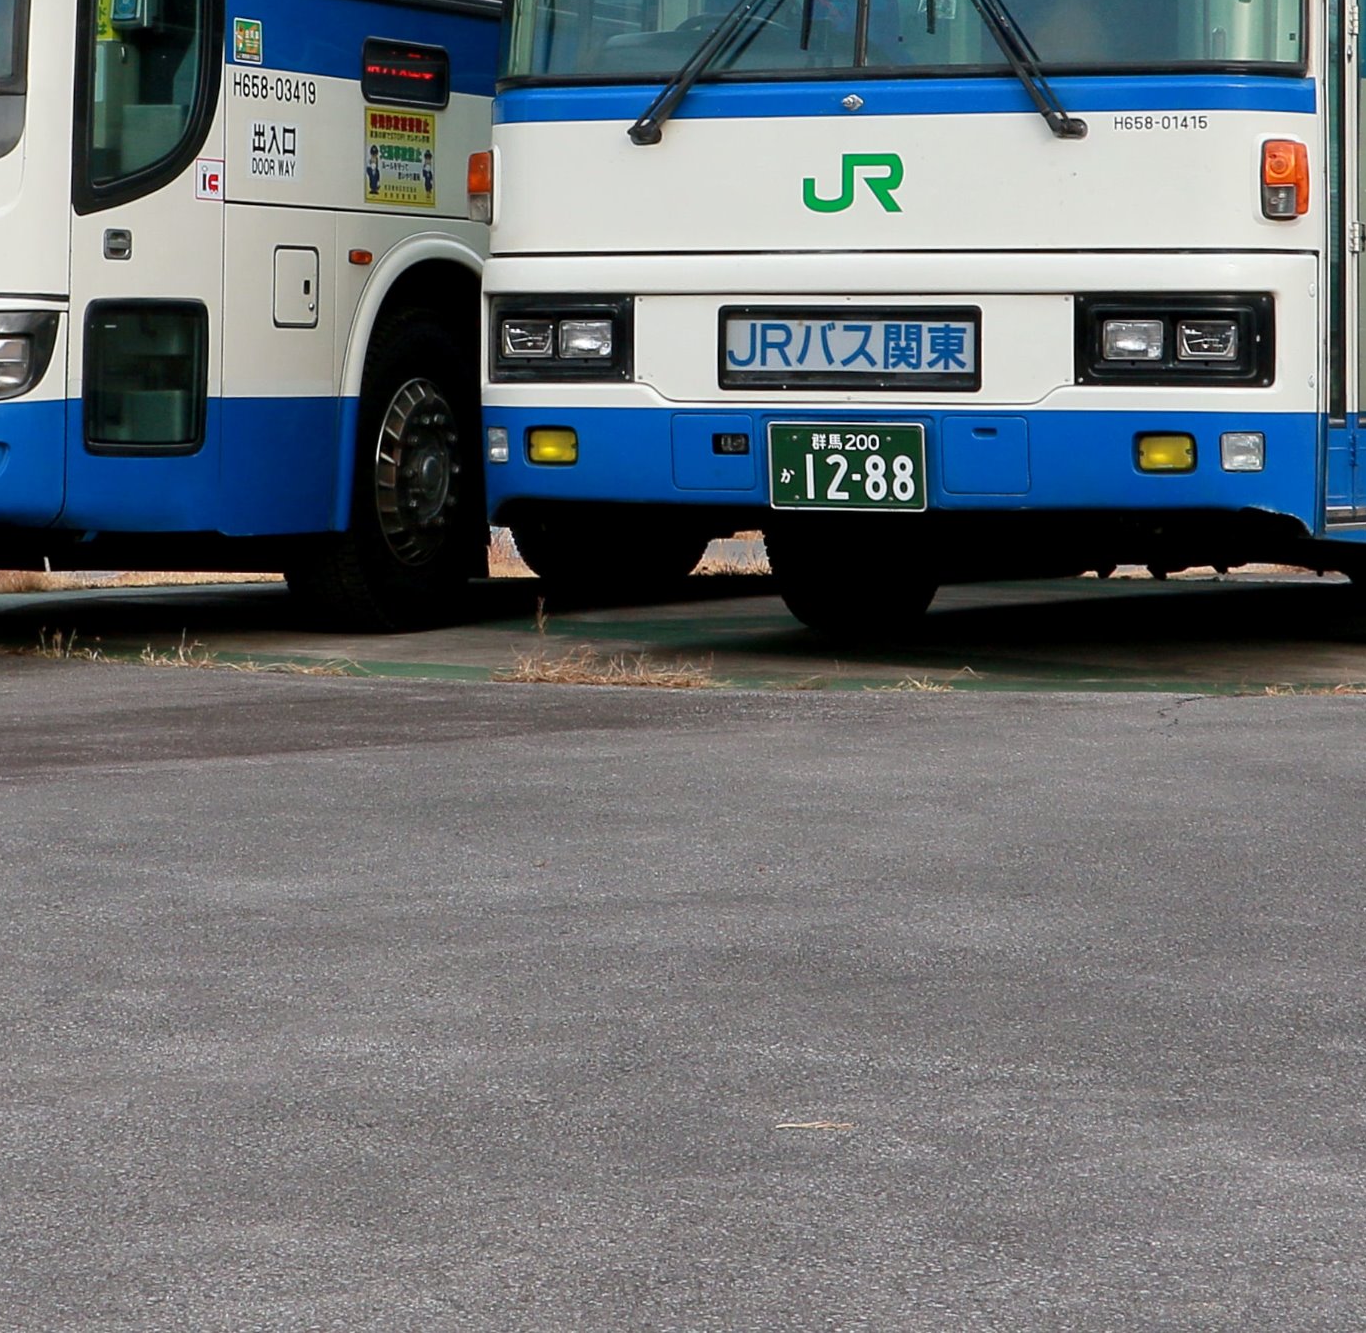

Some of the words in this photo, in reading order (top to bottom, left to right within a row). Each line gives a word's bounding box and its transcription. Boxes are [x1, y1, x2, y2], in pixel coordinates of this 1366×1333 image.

[233, 72, 317, 105] H658-03419
[252, 123, 296, 157] 出入口
[1113, 116, 1208, 131] H658-01415
[251, 157, 275, 176] DOOR
[278, 159, 296, 177] WAY
[803, 153, 904, 213] JR
[727, 322, 968, 370] JRバス関東
[780, 468, 795, 484] か
[805, 453, 915, 501] 12-88
